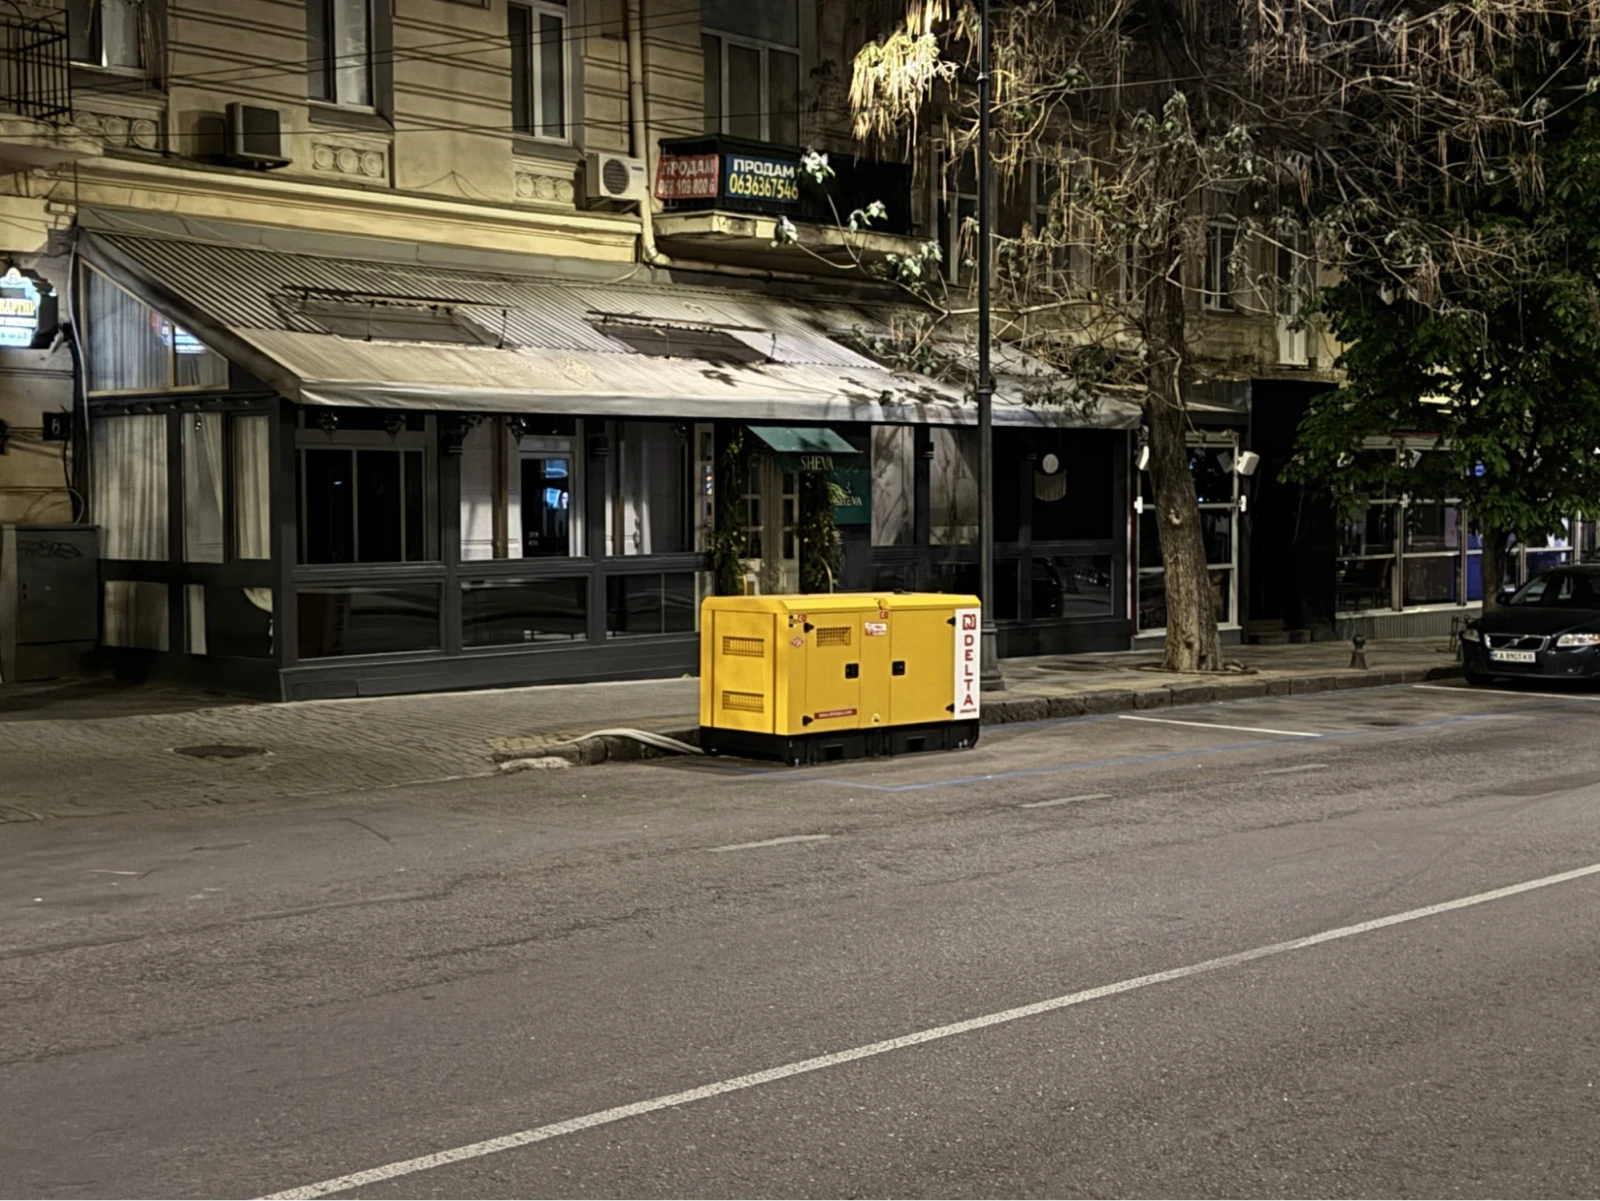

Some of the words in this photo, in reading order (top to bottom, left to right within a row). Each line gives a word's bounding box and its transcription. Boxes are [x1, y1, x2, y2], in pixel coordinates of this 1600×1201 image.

[660, 159, 715, 176] ПРОДАМ
[733, 158, 795, 178] ПРОДАМ
[729, 172, 799, 200] 0636367546
[800, 455, 834, 471] SHEVA
[963, 634, 975, 706] DELTA
